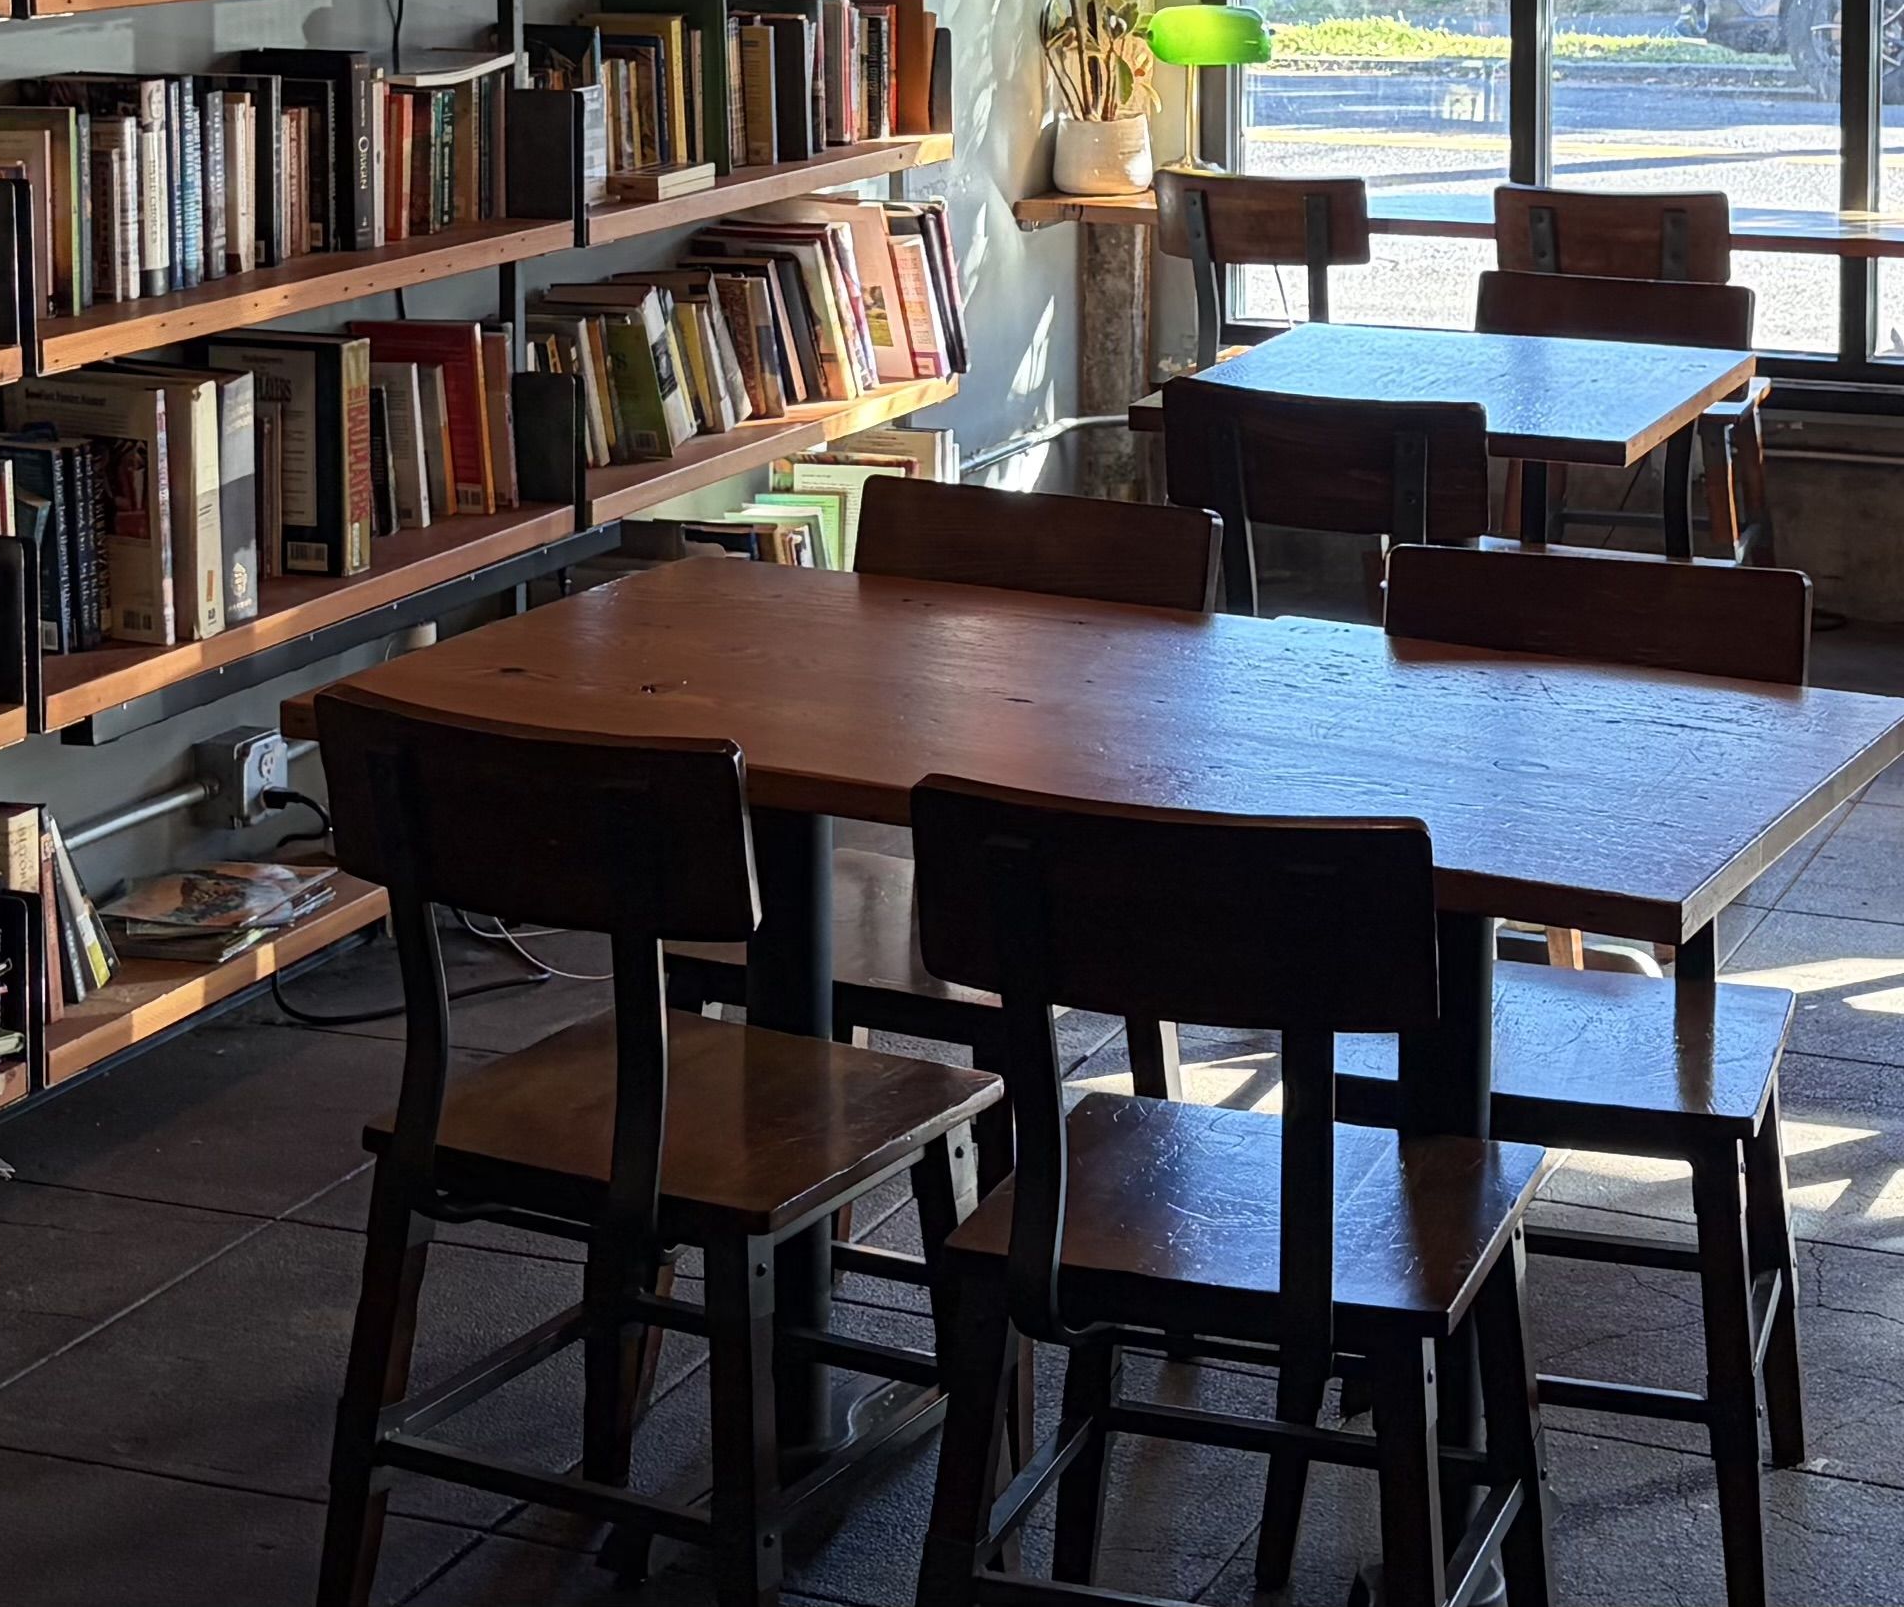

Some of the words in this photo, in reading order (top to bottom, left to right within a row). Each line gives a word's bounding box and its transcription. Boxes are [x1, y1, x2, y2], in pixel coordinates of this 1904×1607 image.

[184, 95, 193, 131] DAVID
[357, 136, 371, 191] ORIGIN
[149, 195, 158, 244] CHOICES
